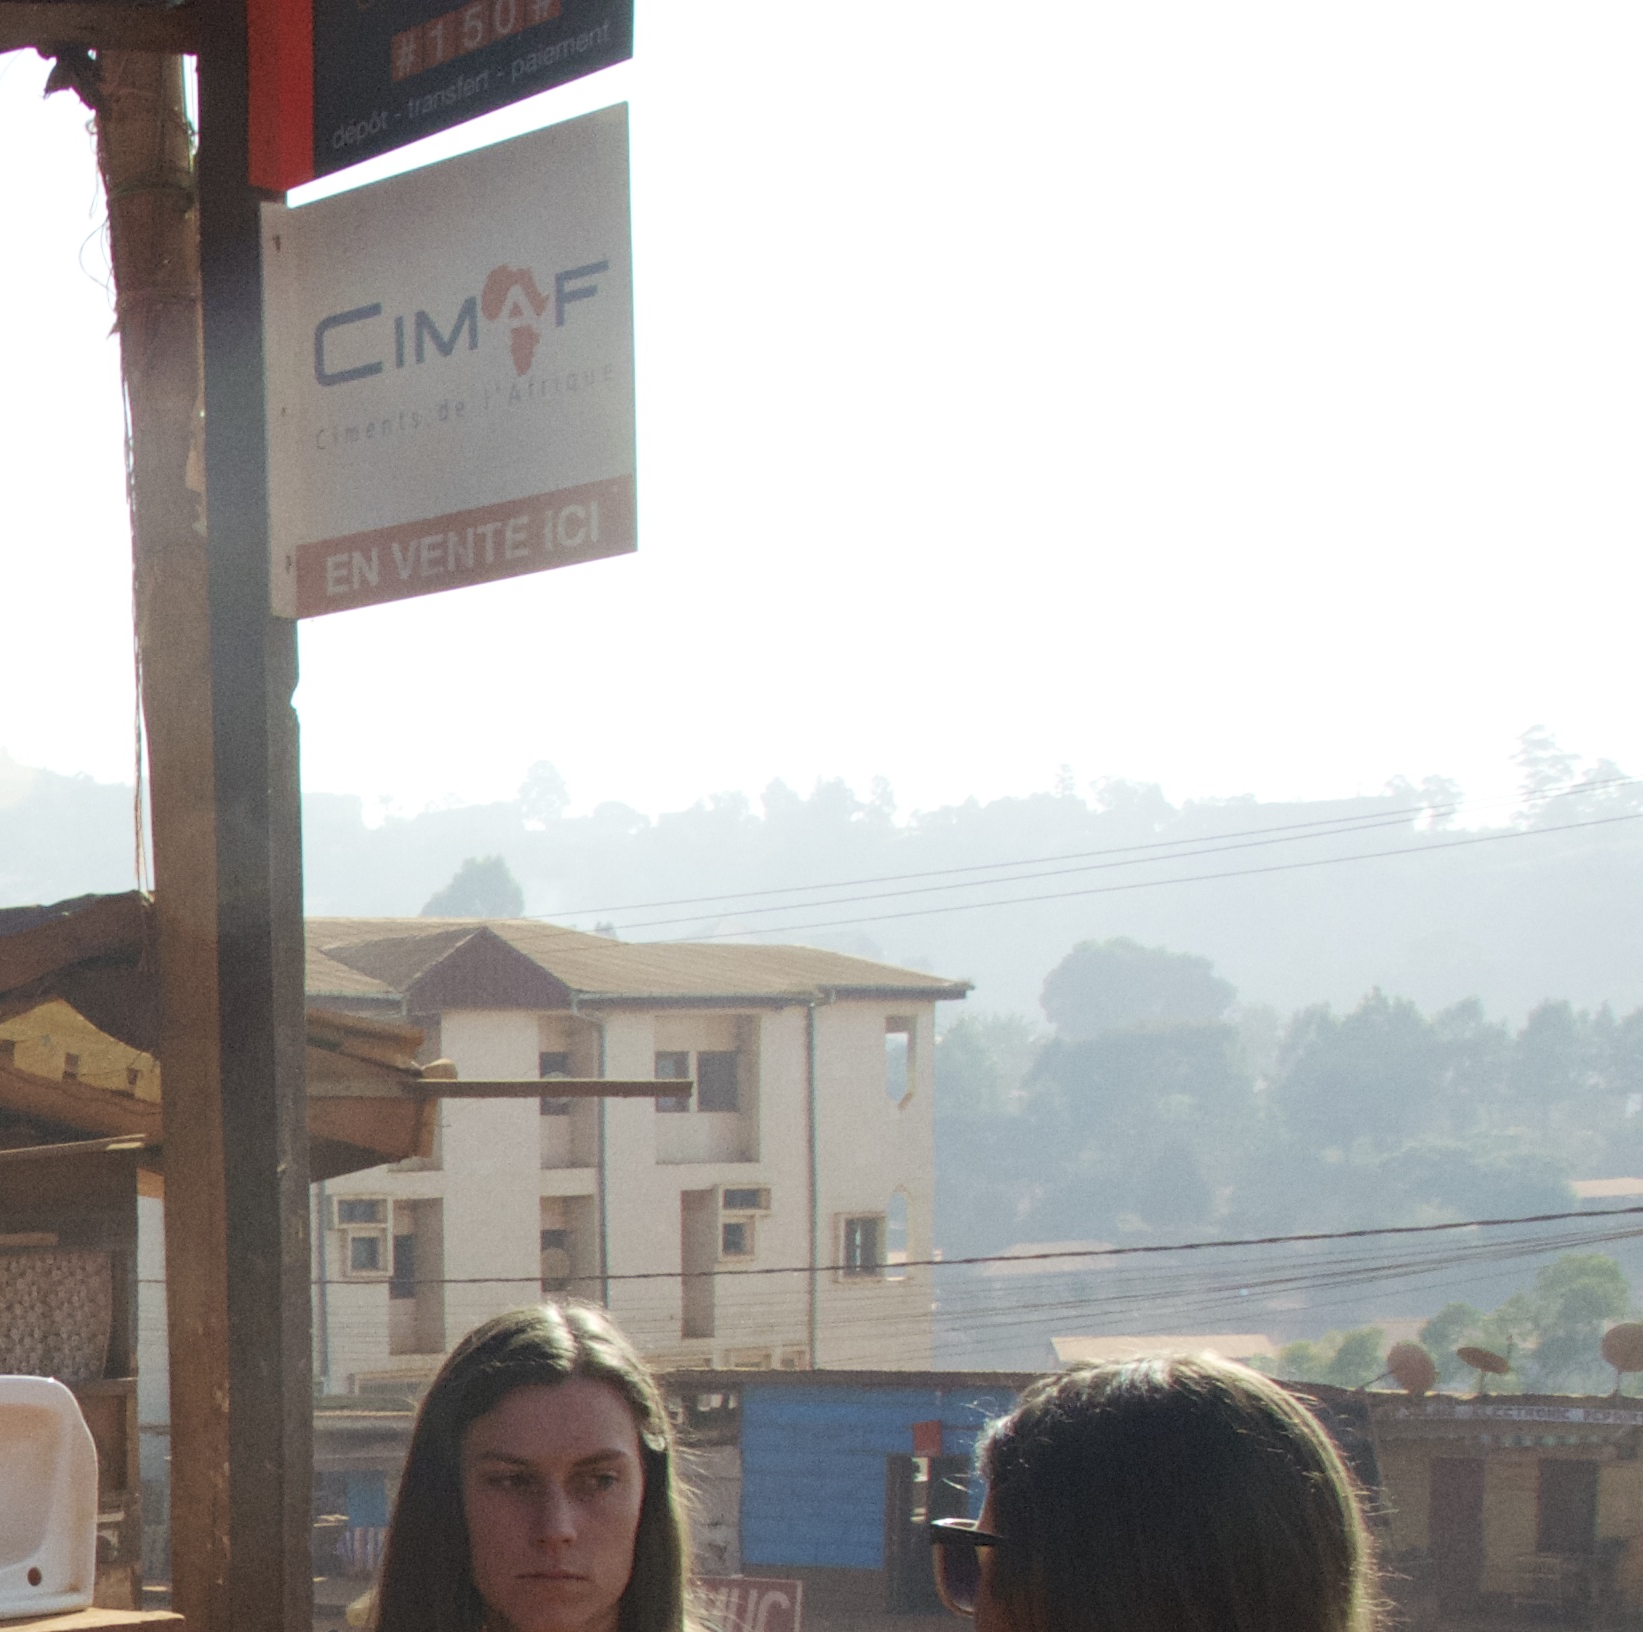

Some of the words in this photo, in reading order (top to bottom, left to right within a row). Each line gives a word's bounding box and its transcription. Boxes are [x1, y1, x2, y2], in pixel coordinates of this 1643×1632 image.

[408, 68, 490, 118] transfert
[511, 19, 613, 82] paiement
[314, 260, 609, 387] CIMAF
[315, 410, 421, 452] Ciments
[438, 401, 466, 422] de
[325, 547, 380, 596] EN
[391, 513, 531, 580] VENTE
[543, 500, 600, 550] ICI
